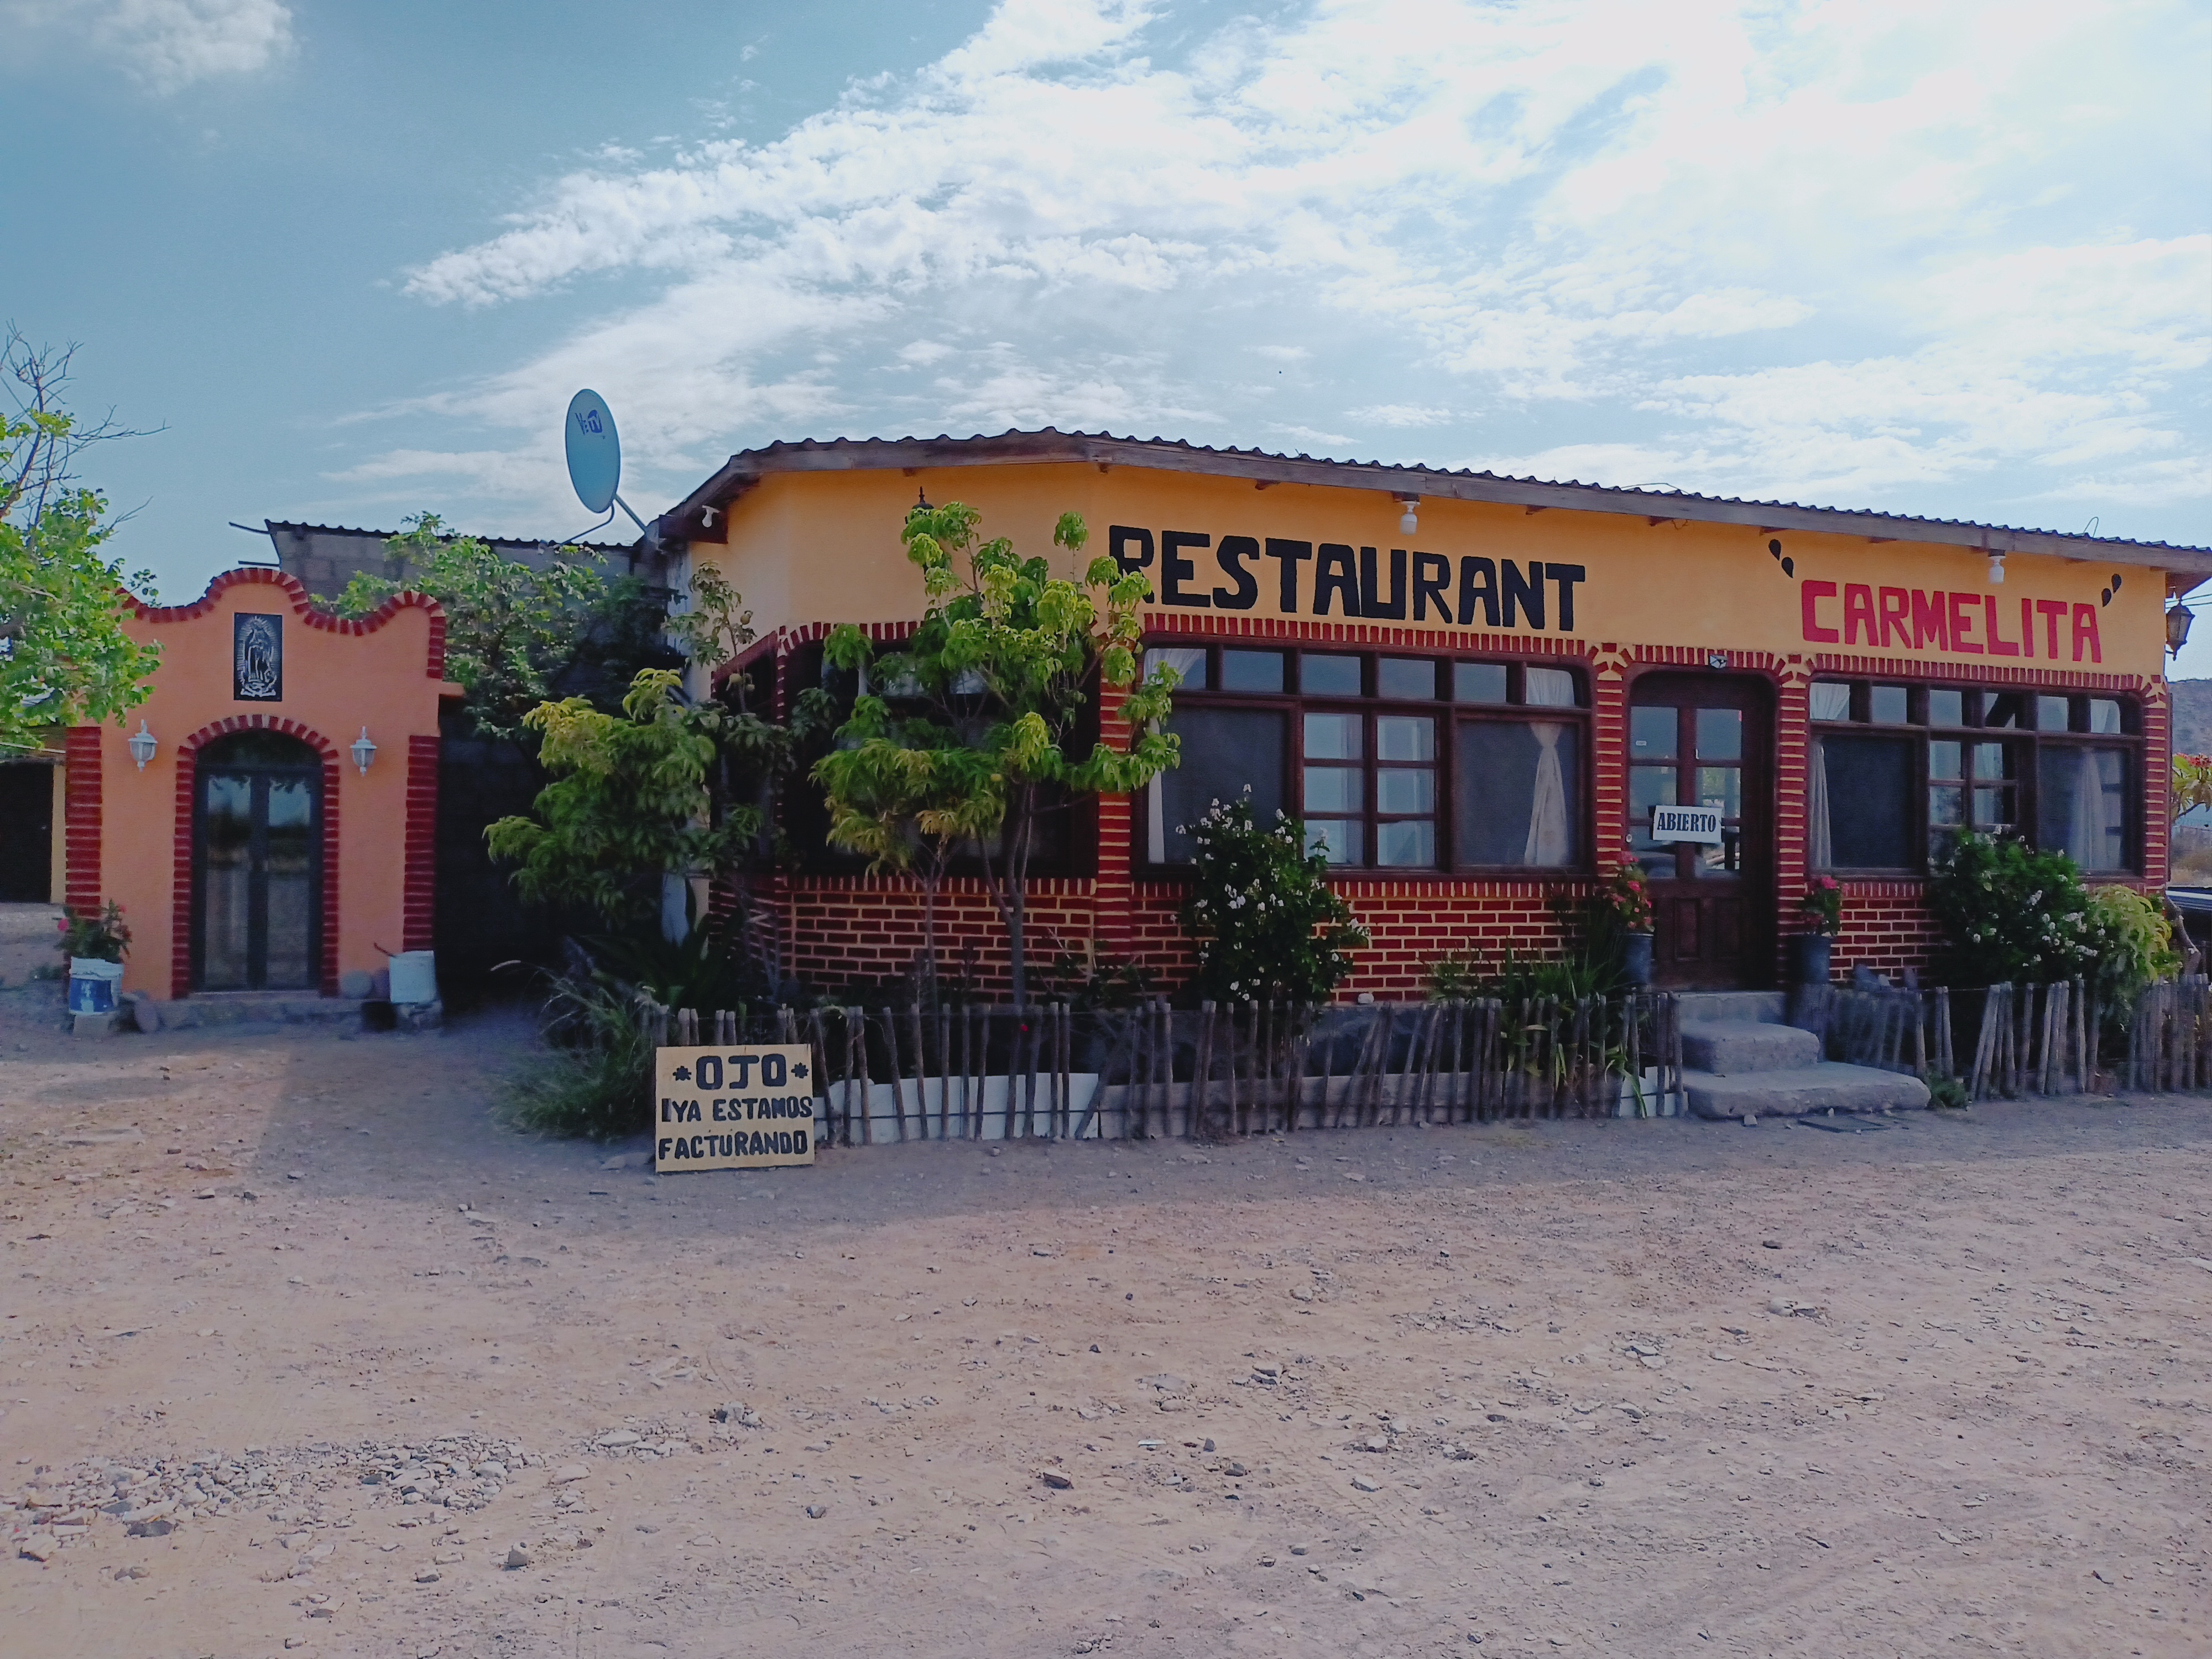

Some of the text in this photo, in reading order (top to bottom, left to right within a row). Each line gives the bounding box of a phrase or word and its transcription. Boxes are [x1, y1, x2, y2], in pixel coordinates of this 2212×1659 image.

[1108, 525, 2102, 664] RESTAURANT CARMELITA
[1656, 812, 1717, 833] ABIERTO
[696, 1053, 787, 1091] OJO
[712, 1095, 813, 1122] ESTAMOS
[658, 1130, 808, 1160] FACTURANDO
